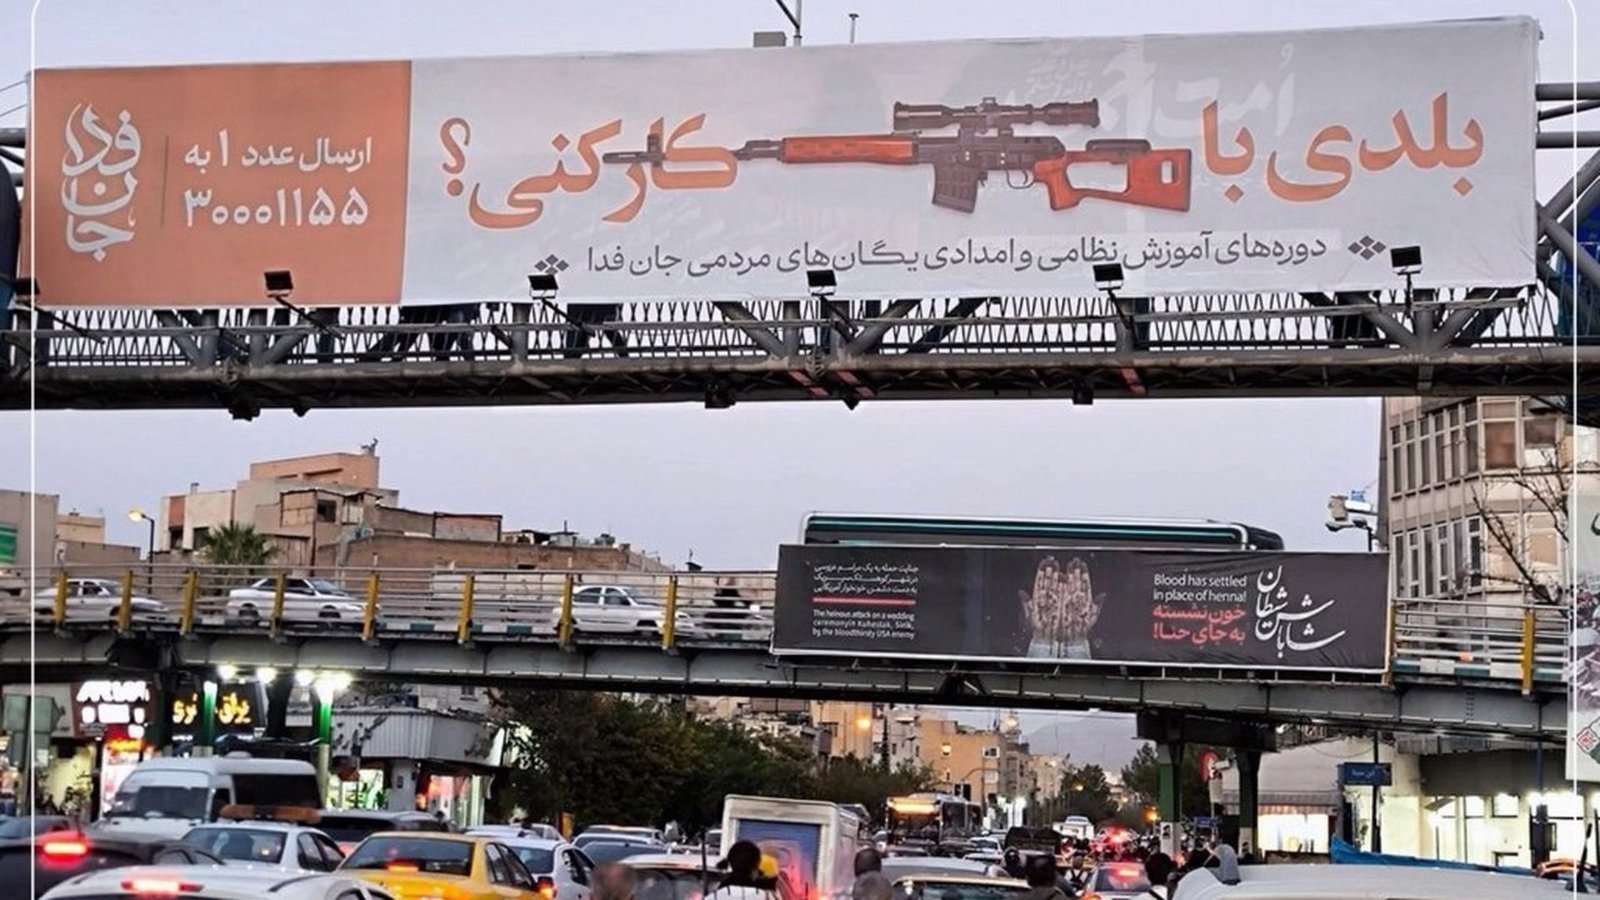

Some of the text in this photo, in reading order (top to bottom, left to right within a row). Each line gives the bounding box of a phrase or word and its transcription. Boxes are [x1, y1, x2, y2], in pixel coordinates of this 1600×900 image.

[184, 143, 212, 175] به
[241, 144, 295, 167] عدد
[298, 136, 373, 173] ارسال
[1201, 99, 1256, 203] با
[1266, 91, 1484, 202] بلدی
[601, 112, 738, 223] کار
[184, 186, 370, 228] ۳۰۰۰۱۱۵۵
[588, 245, 625, 272] فدا
[628, 244, 683, 277] جان
[686, 251, 772, 277] مردمی
[923, 238, 1014, 270] امدادی
[1014, 249, 1032, 272] و
[1036, 236, 1118, 272] نظامی
[1122, 229, 1214, 270] آموزش
[1153, 588, 1247, 603] in place of henna!
[1154, 573, 1248, 588] Blood has settled
[813, 609, 825, 618] The
[1153, 602, 1247, 625] خون نشسته
[1228, 627, 1247, 646] به
